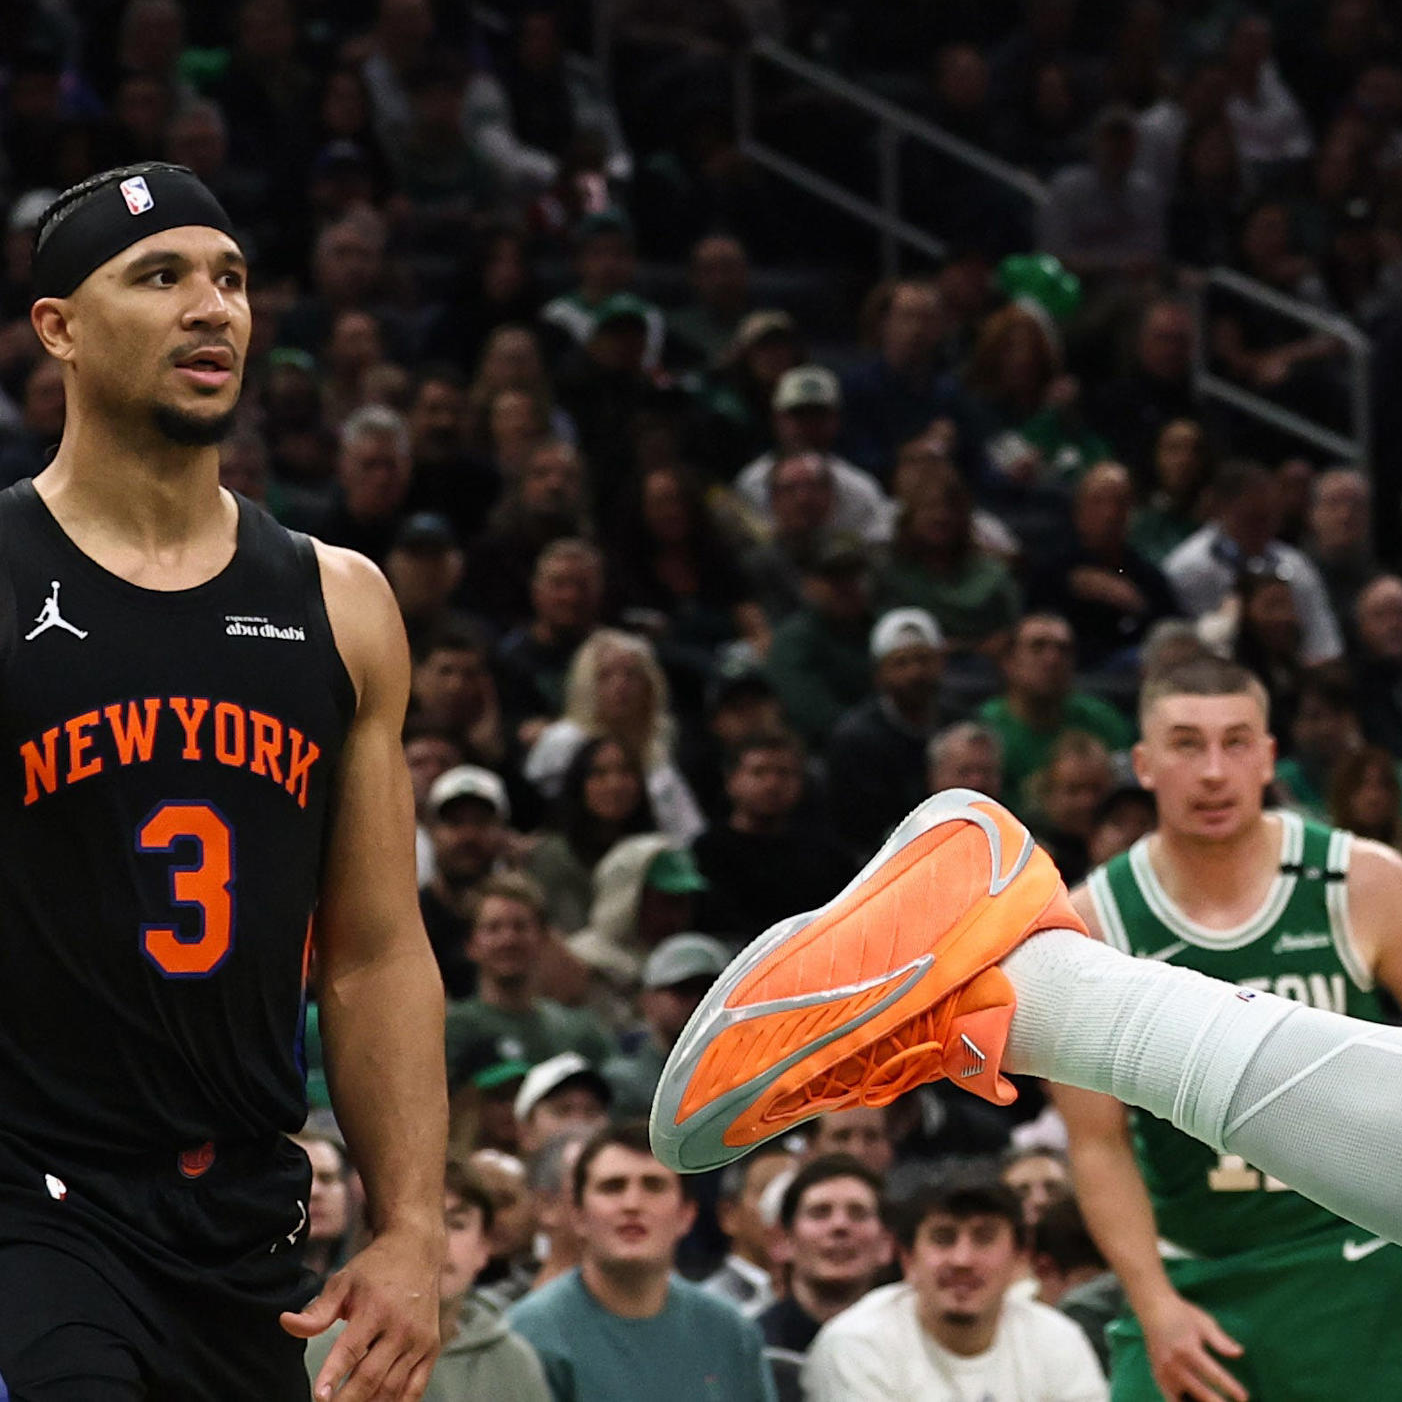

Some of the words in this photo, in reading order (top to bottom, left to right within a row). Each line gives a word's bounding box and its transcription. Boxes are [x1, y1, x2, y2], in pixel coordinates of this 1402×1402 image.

[226, 622, 258, 636] abu
[259, 624, 305, 641] dhabi
[20, 698, 162, 806] NEW
[168, 697, 321, 809] YORK
[135, 799, 235, 978] 3
